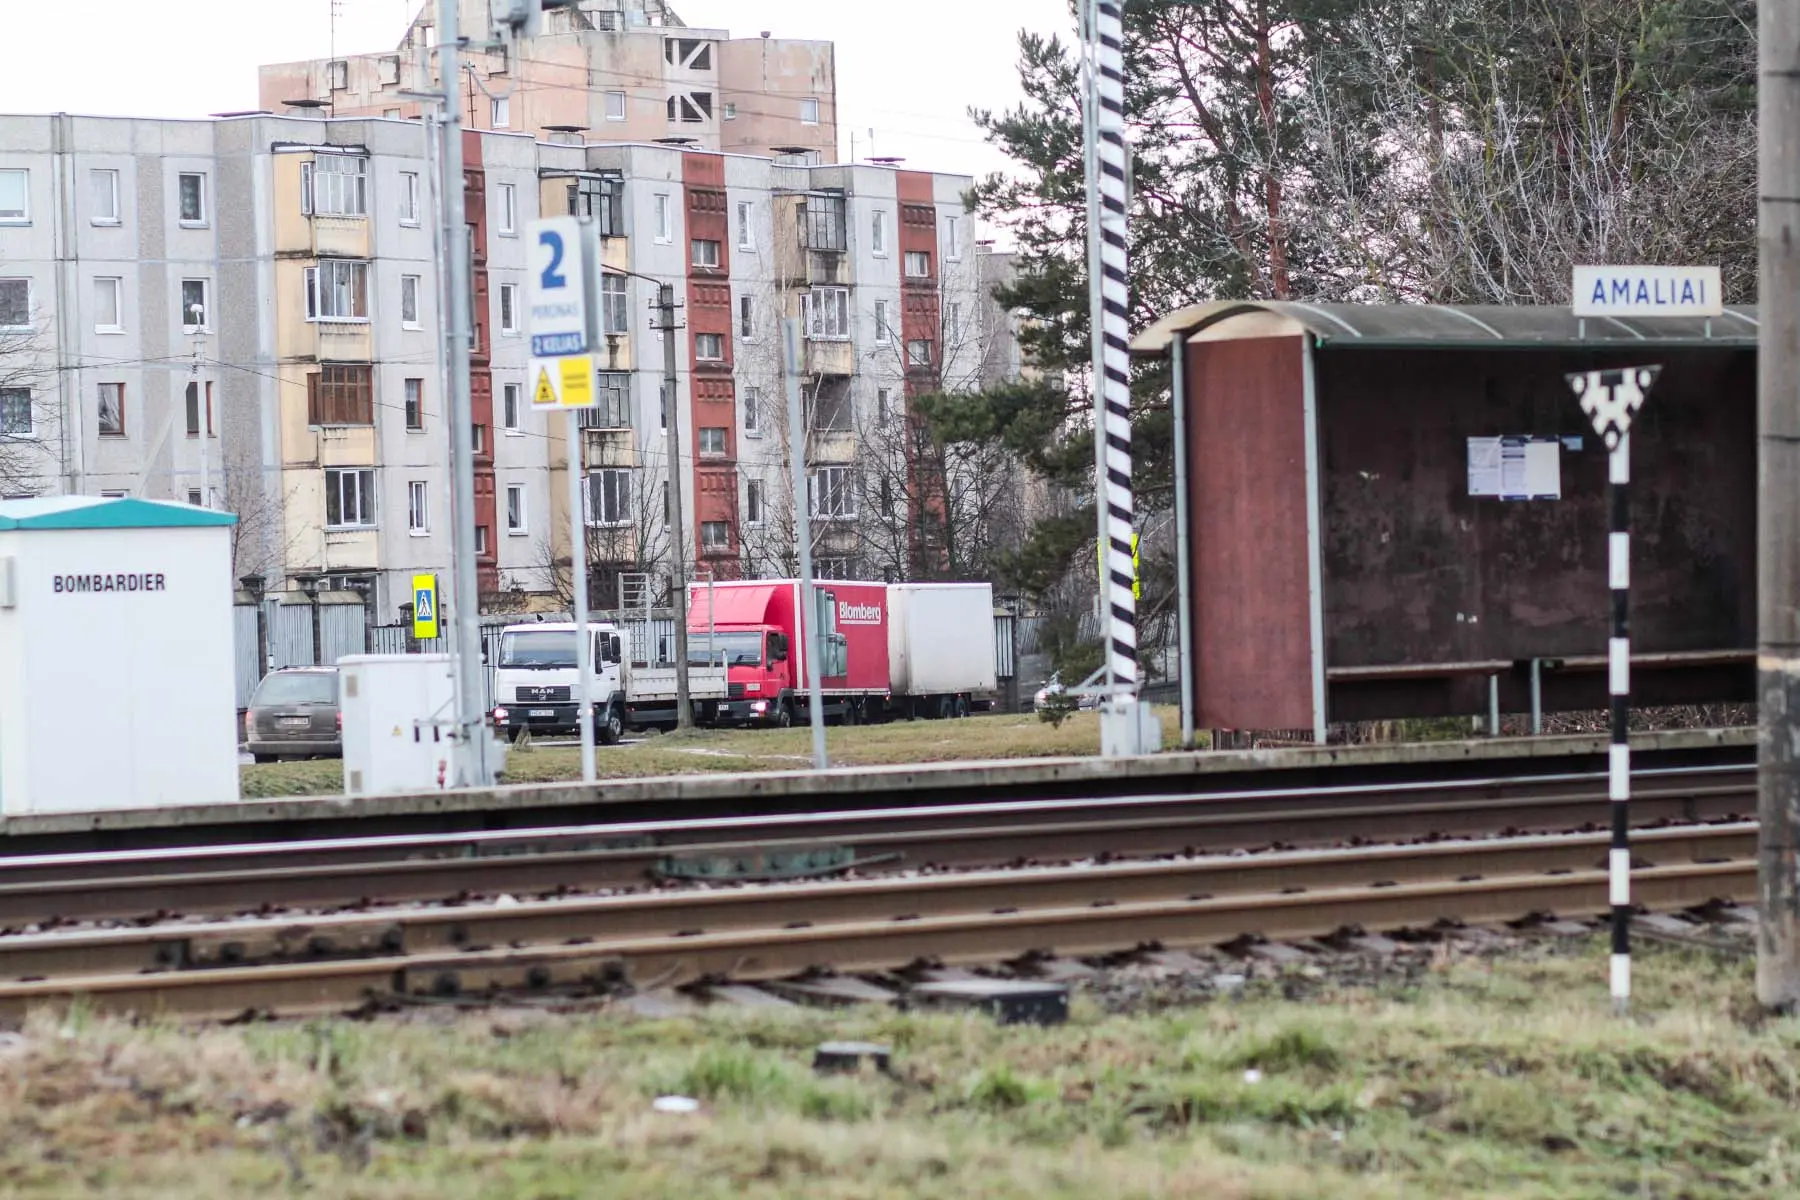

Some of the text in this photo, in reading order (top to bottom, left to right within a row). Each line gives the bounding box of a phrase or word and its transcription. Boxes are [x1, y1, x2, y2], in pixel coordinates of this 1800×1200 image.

[538, 230, 567, 290] 2
[1591, 278, 1705, 305] AMALIAI
[53, 573, 166, 593] BOMBARDIER
[839, 601, 881, 625] Blomberg
